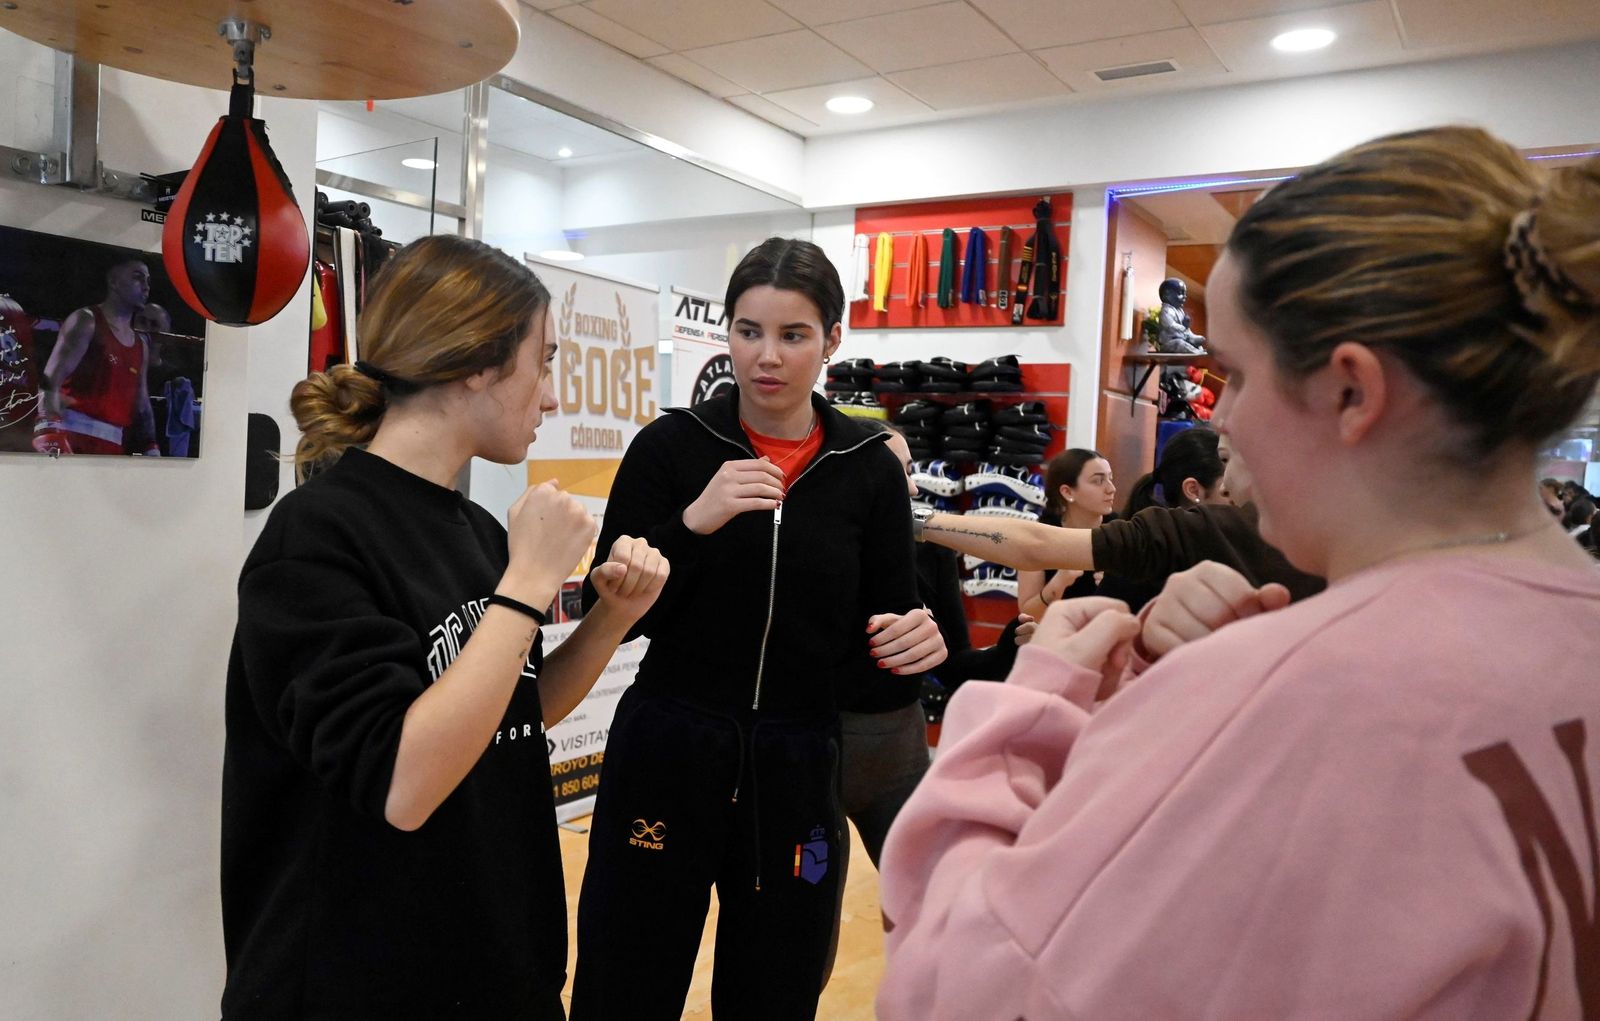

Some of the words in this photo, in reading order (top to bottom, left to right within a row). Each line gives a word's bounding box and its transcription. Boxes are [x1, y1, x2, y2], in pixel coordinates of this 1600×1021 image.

[204, 223, 243, 243] TOP
[202, 242, 243, 263] TEN
[574, 312, 618, 342] BOXING
[674, 324, 705, 338] DEFENSA
[545, 335, 656, 428] GOGE
[571, 423, 624, 451] CÓRDOBA
[561, 778, 581, 797] 850
[581, 772, 599, 790] 604
[629, 837, 664, 850] STING
